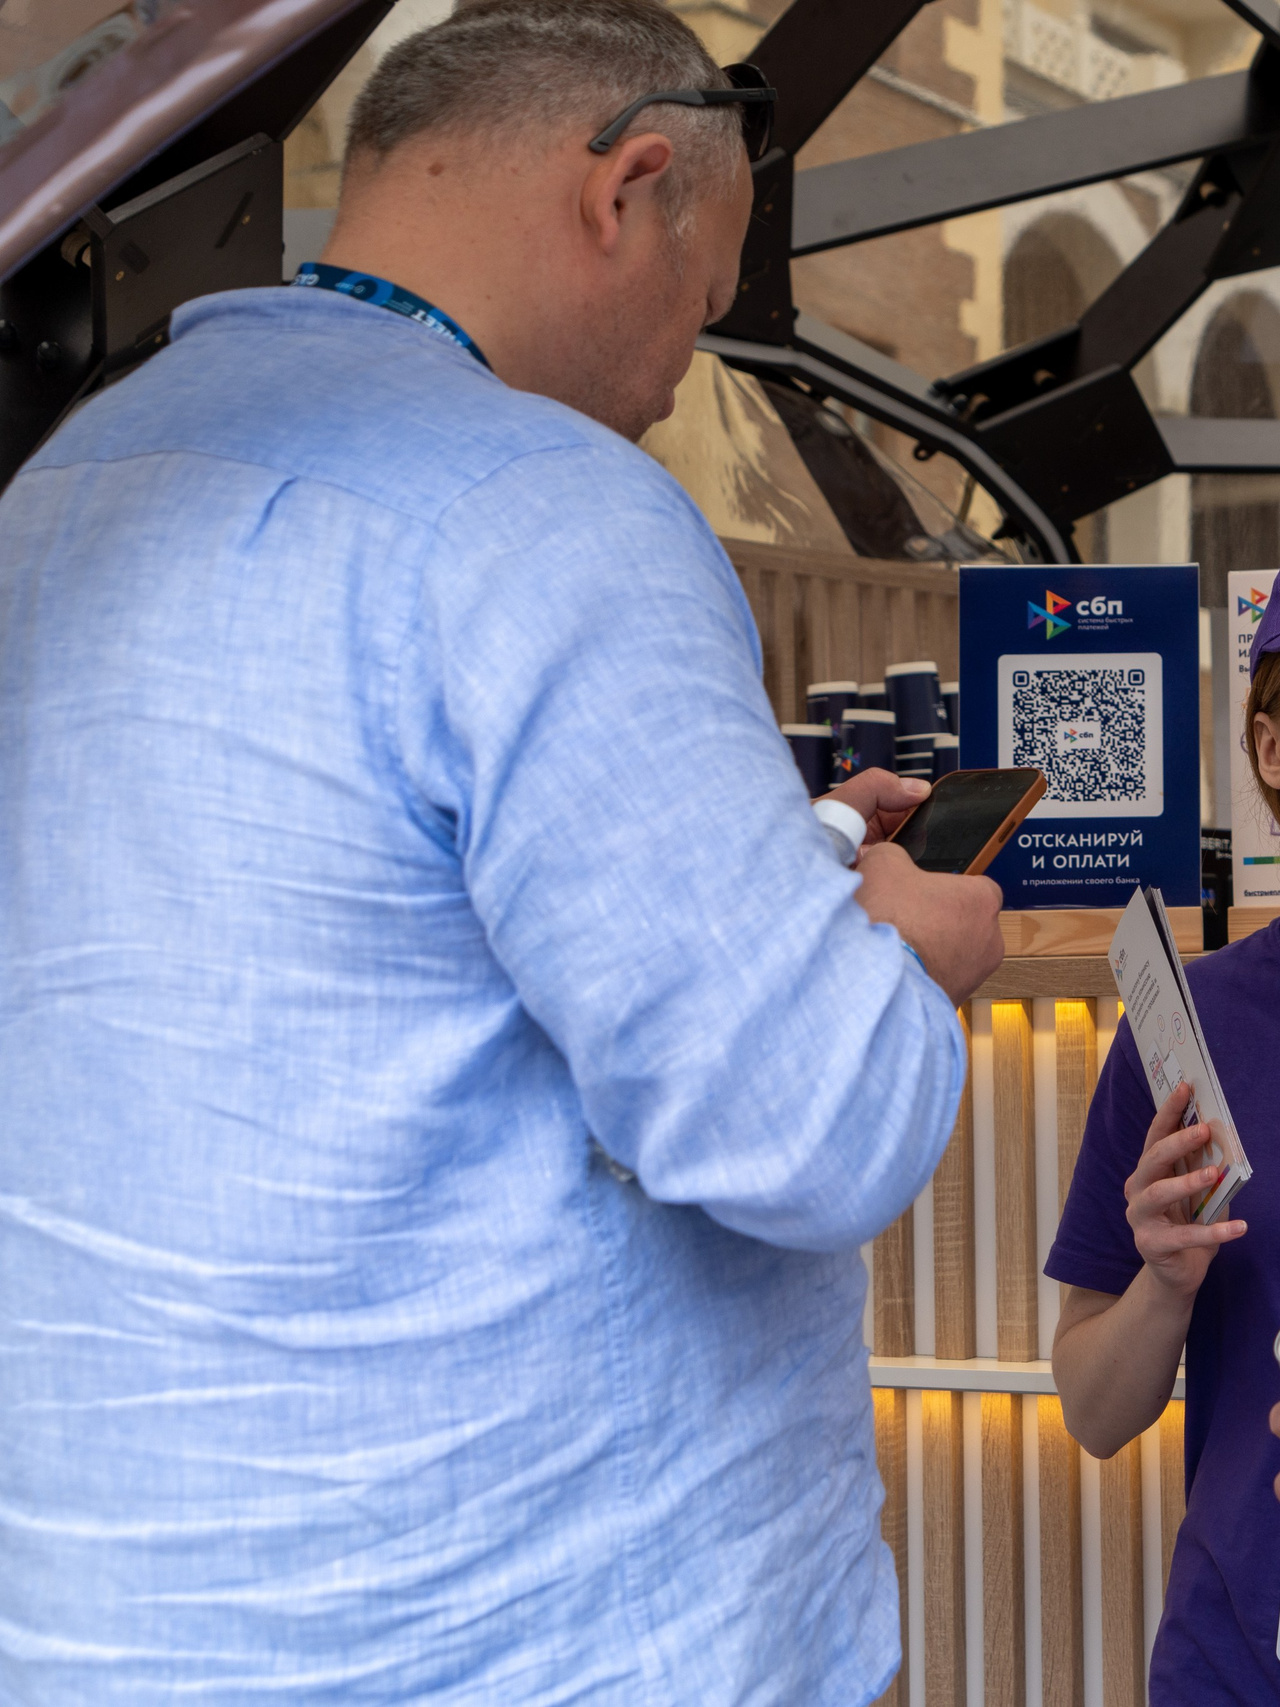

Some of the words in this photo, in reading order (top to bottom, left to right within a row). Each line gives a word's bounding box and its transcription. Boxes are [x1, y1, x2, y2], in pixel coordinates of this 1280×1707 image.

[1076, 596, 1123, 616] сбп
[1018, 829, 1143, 848] ОТСКАНИРУЙ
[1032, 855, 1045, 869] И
[1053, 854, 1130, 869] ОПЛАТИ
[1029, 878, 1083, 888] приложении
[1084, 878, 1114, 886] своего
[1115, 876, 1141, 885] банка
